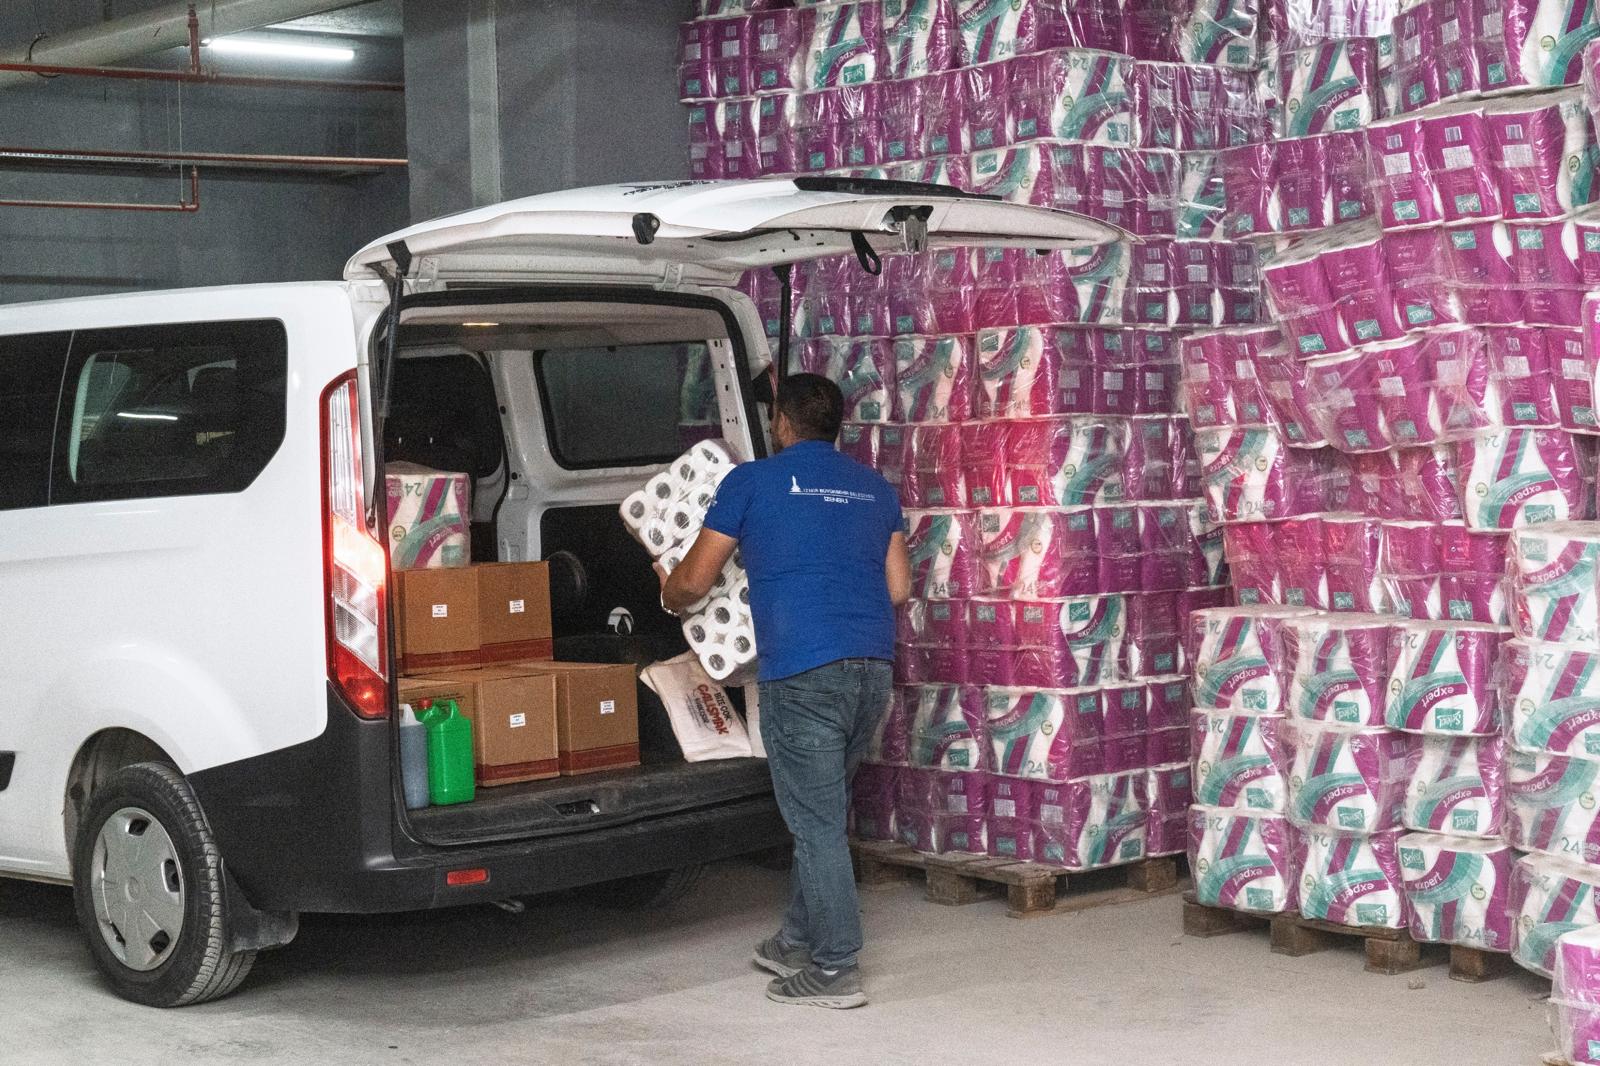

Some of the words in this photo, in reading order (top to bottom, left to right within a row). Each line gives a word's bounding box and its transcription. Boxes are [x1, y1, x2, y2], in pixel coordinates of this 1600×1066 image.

[1484, 435, 1500, 448] 24
[404, 482, 423, 497] 24
[1509, 485, 1542, 506] expert
[1530, 563, 1567, 583] expert
[932, 582, 946, 595] 24
[1228, 669, 1257, 689] expert
[1324, 683, 1349, 700] expert
[1422, 686, 1455, 708] expert
[1211, 718, 1225, 733] 24
[1437, 711, 1462, 727] Select
[1027, 760, 1044, 774] 24
[1521, 776, 1552, 793] expert
[1323, 787, 1353, 805] expert
[1443, 790, 1472, 808] expert
[1208, 817, 1223, 831] 24
[1561, 836, 1581, 854] 24
[1341, 882, 1375, 903] expert
[1463, 924, 1481, 939] 24
